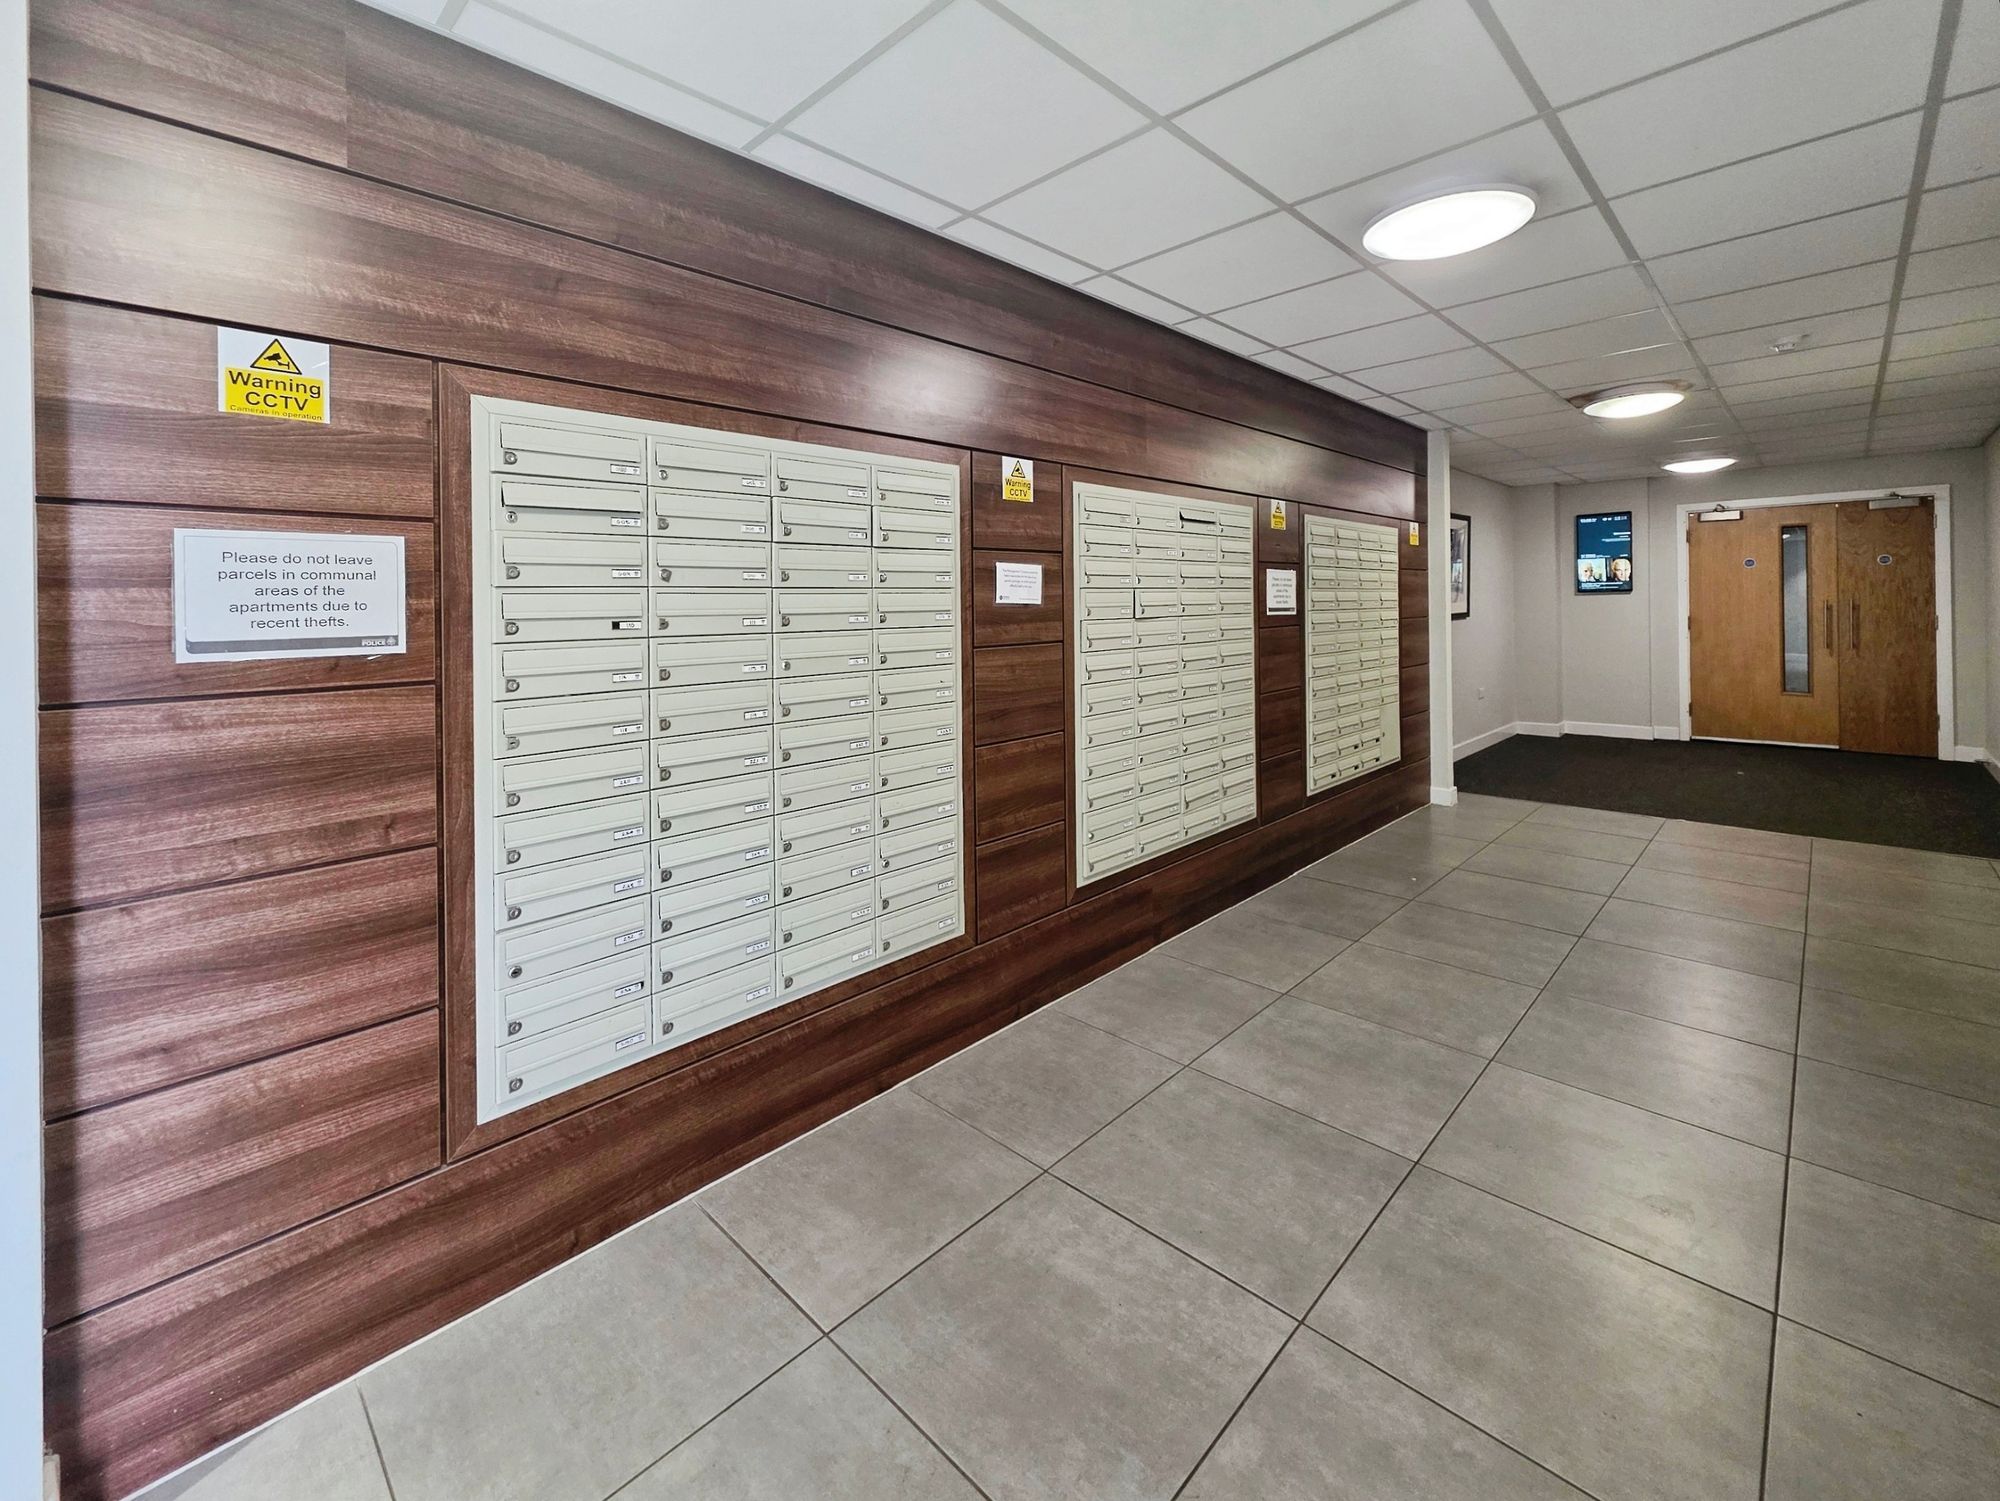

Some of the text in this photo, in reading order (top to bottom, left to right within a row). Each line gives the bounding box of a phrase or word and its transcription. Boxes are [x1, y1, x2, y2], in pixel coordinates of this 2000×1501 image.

[228, 370, 321, 399] Warning
[245, 391, 308, 411] CCTV
[230, 404, 270, 415] Cameras
[282, 411, 322, 421] operation
[1005, 478, 1031, 491] Warning
[1009, 488, 1028, 498] CCTV
[222, 551, 373, 566] Please do not leave
[218, 568, 377, 582] parcels in communal
[254, 585, 345, 597] areas of the
[229, 601, 368, 615] apartments due to
[250, 616, 349, 629] recent thefts.
[361, 639, 386, 647] POLICE
